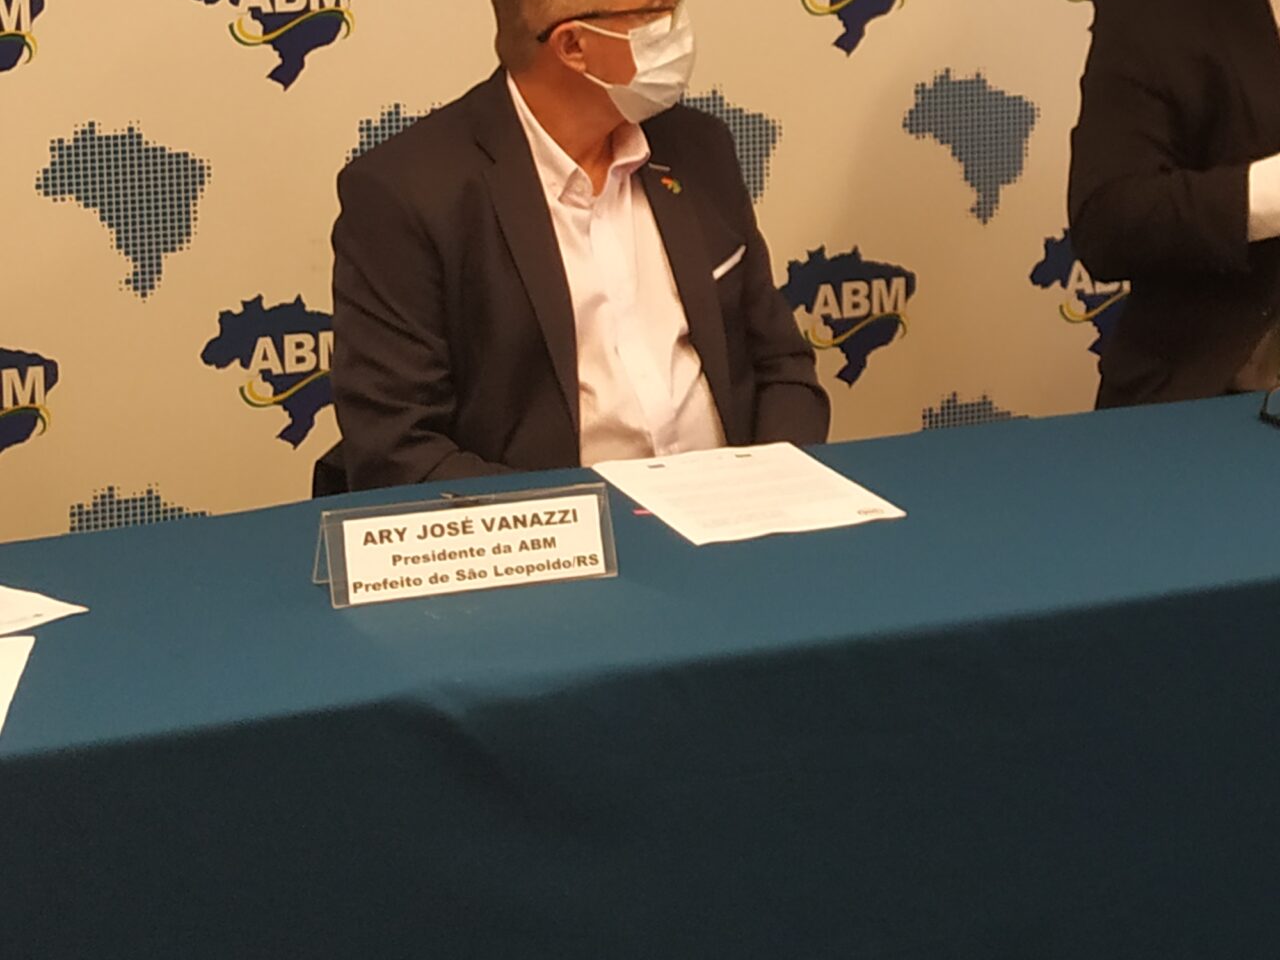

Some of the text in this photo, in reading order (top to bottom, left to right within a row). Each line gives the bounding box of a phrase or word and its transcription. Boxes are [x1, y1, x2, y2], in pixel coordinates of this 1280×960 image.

[812, 277, 907, 317] ABM
[363, 508, 578, 546] ARY JOSÉ VANAZZI
[392, 537, 556, 566] Presidente da ABM
[353, 554, 599, 593] Prefeito de São Leopoldo/RS
